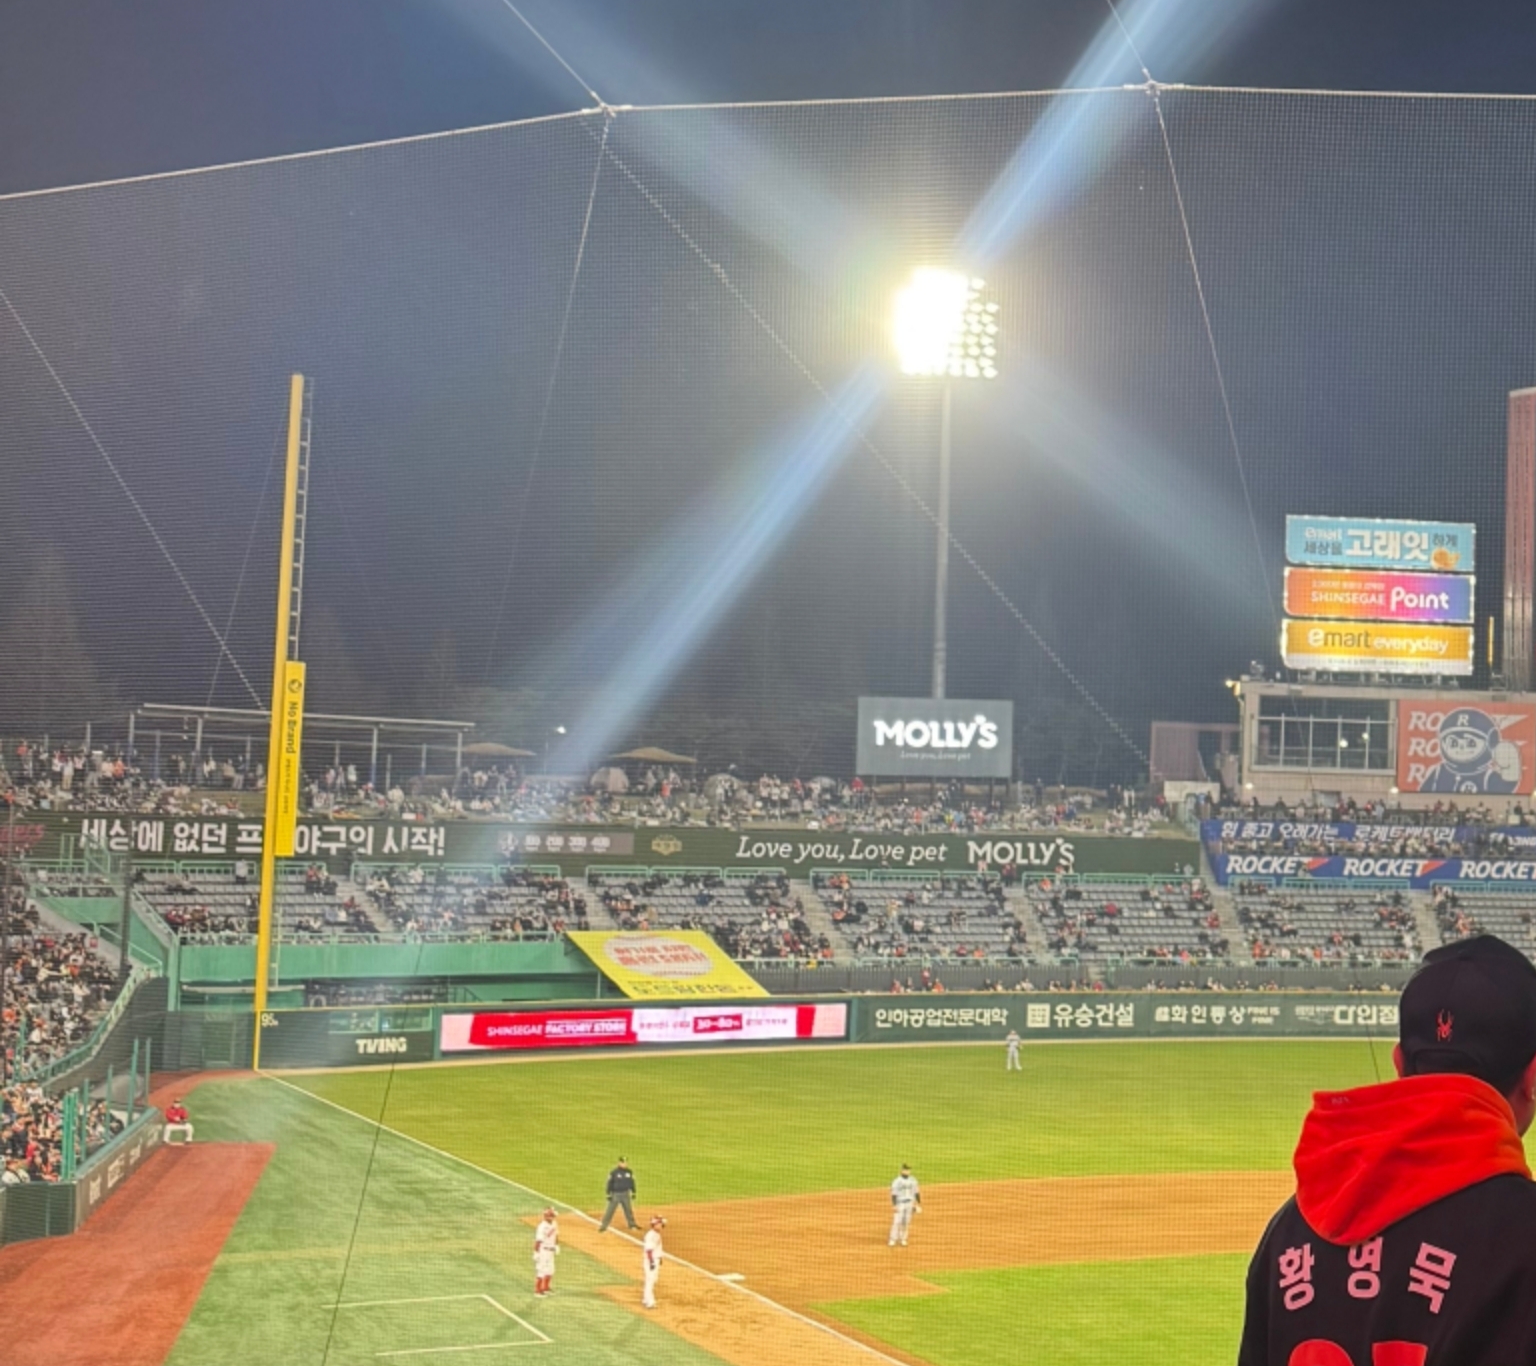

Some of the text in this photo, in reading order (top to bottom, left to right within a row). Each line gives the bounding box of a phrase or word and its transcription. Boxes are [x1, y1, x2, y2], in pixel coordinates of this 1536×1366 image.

[1304, 528, 1458, 561] 세상을 고래잇 하게
[1311, 586, 1450, 612] SHINSEGAE Point
[1308, 627, 1449, 654] emart everyday
[874, 715, 998, 748] MOLLY'S
[79, 818, 164, 852] 세상에
[173, 822, 228, 854] 없던
[235, 823, 374, 856] 프야구의
[735, 836, 1074, 866] Love you, Love pet MOLLY'S
[1226, 855, 1312, 876] ROCKET
[1343, 858, 1427, 878] ROCKET
[1053, 1003, 1134, 1027] 유승건설
[487, 1024, 544, 1036] SHINSEGAE
[355, 1037, 407, 1054] TVING
[1278, 1237, 1457, 1315] 황영묵
